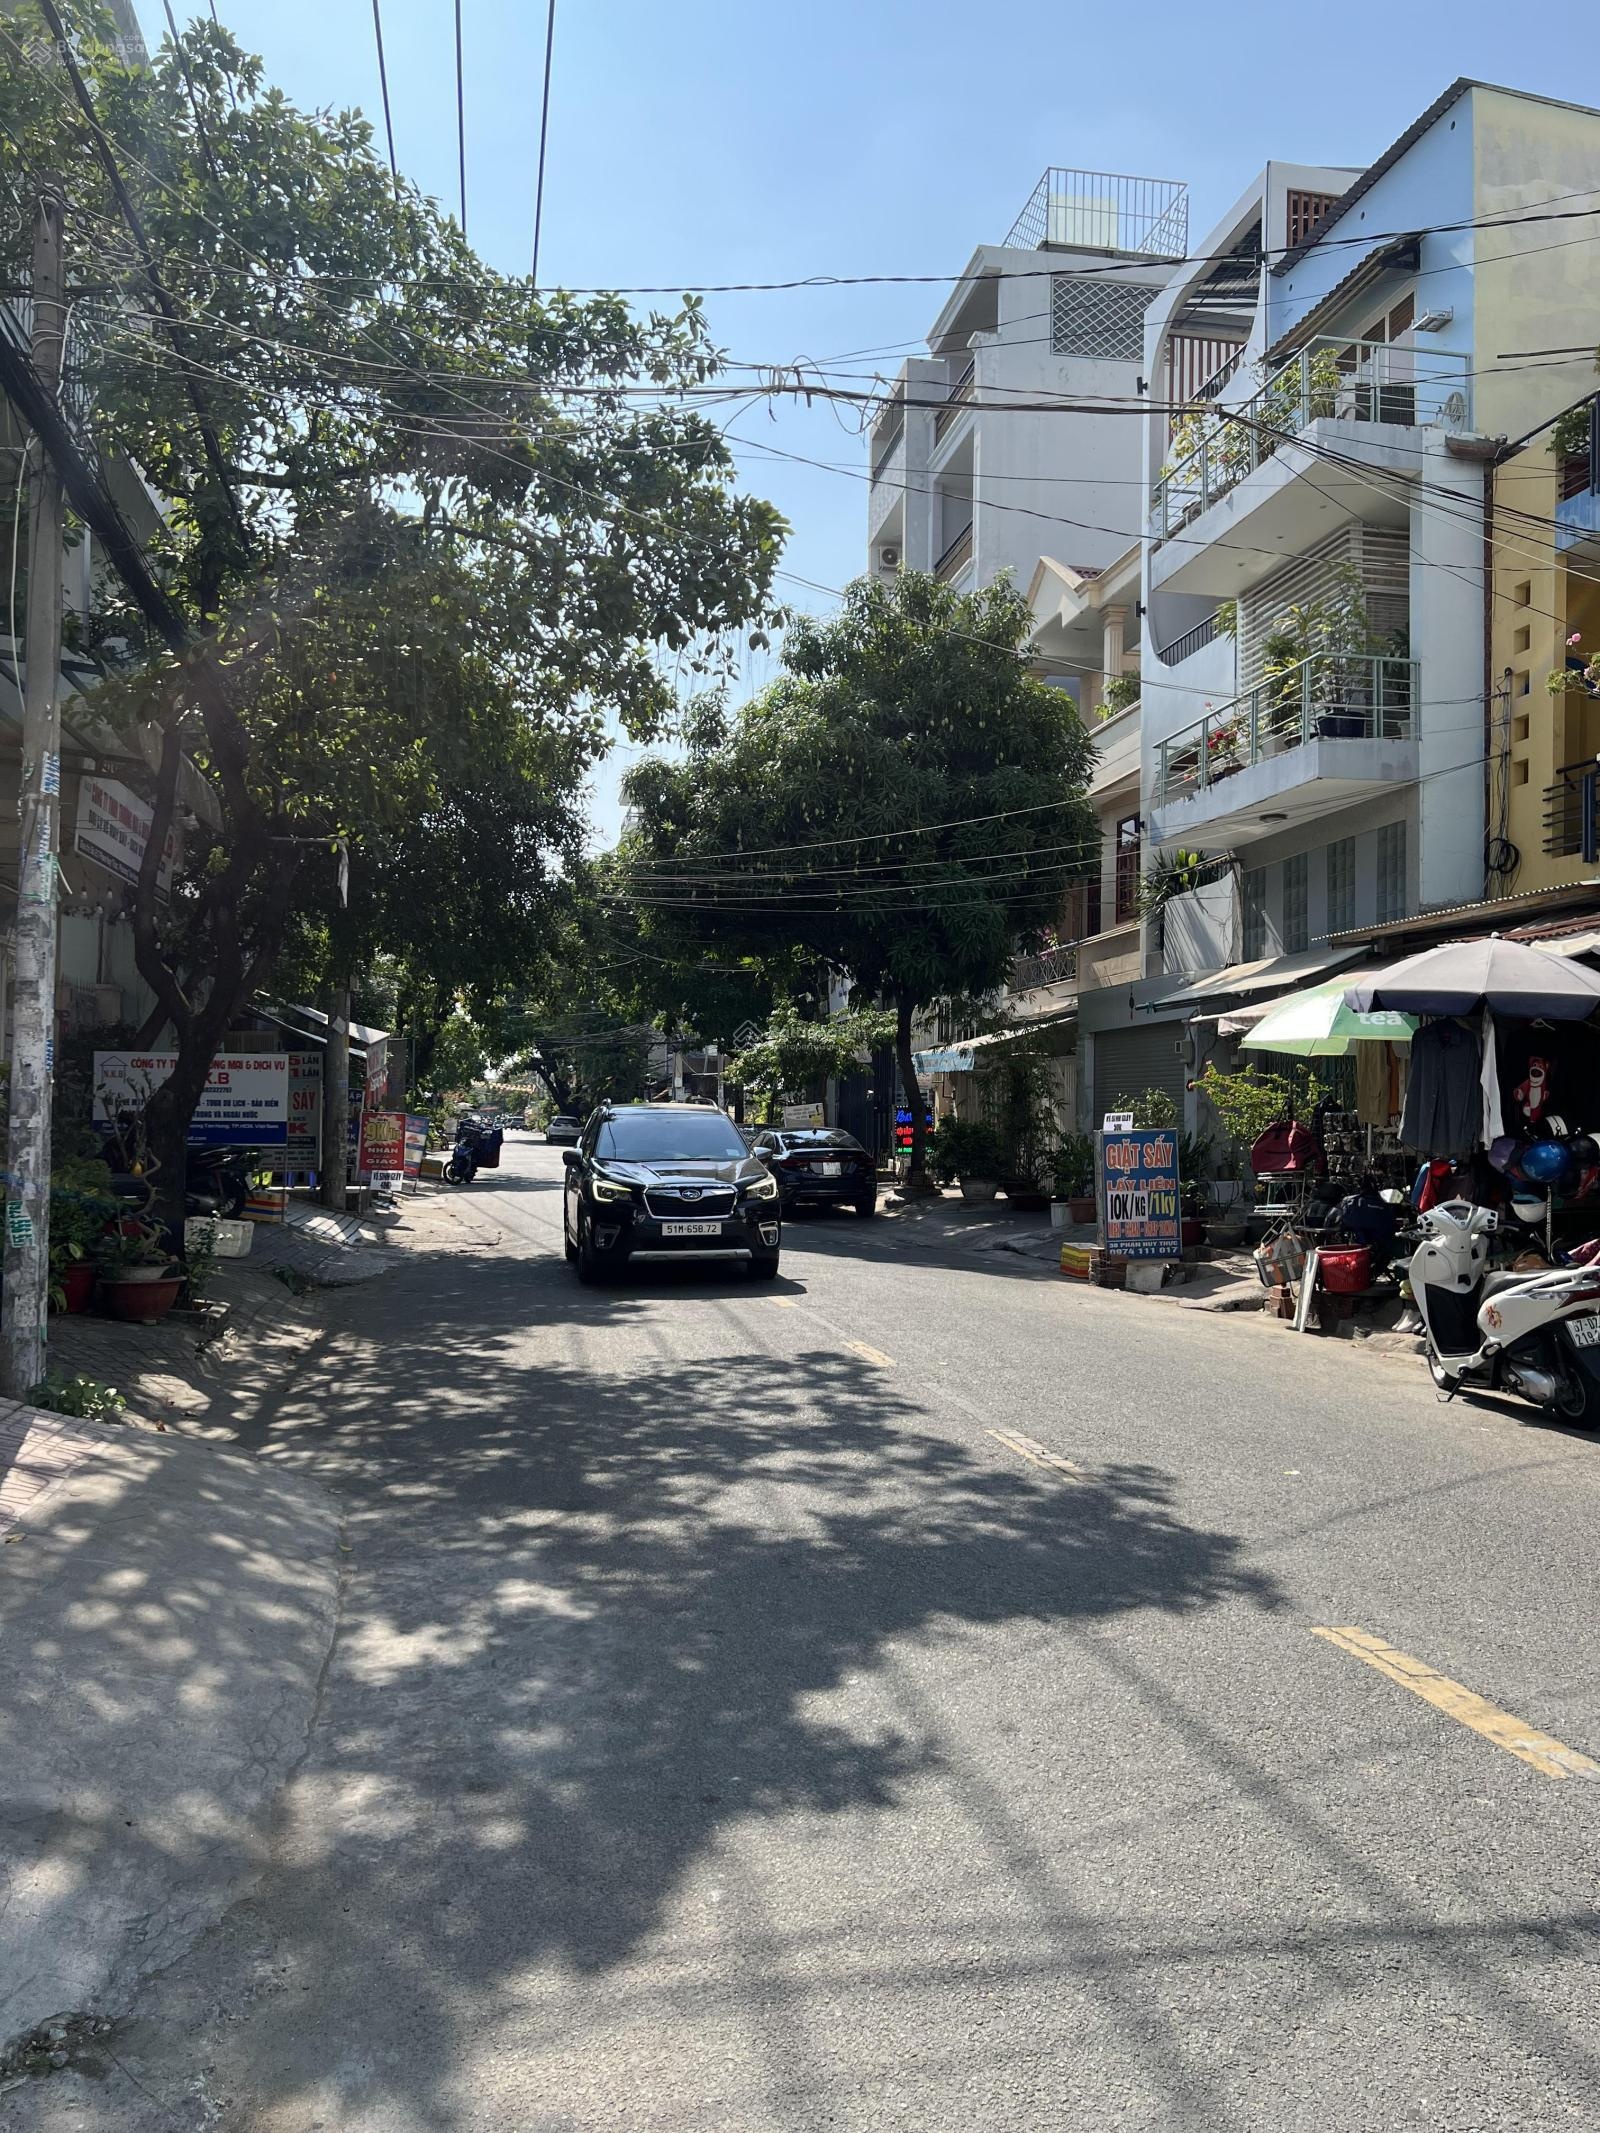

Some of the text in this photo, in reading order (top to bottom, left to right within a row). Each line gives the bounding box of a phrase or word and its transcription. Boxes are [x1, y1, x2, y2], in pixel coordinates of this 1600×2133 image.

[156, 1059, 168, 1069] TY
[1106, 1134, 1174, 1174] GIẶT SẤY
[667, 1224, 717, 1234] 51M-658.72
